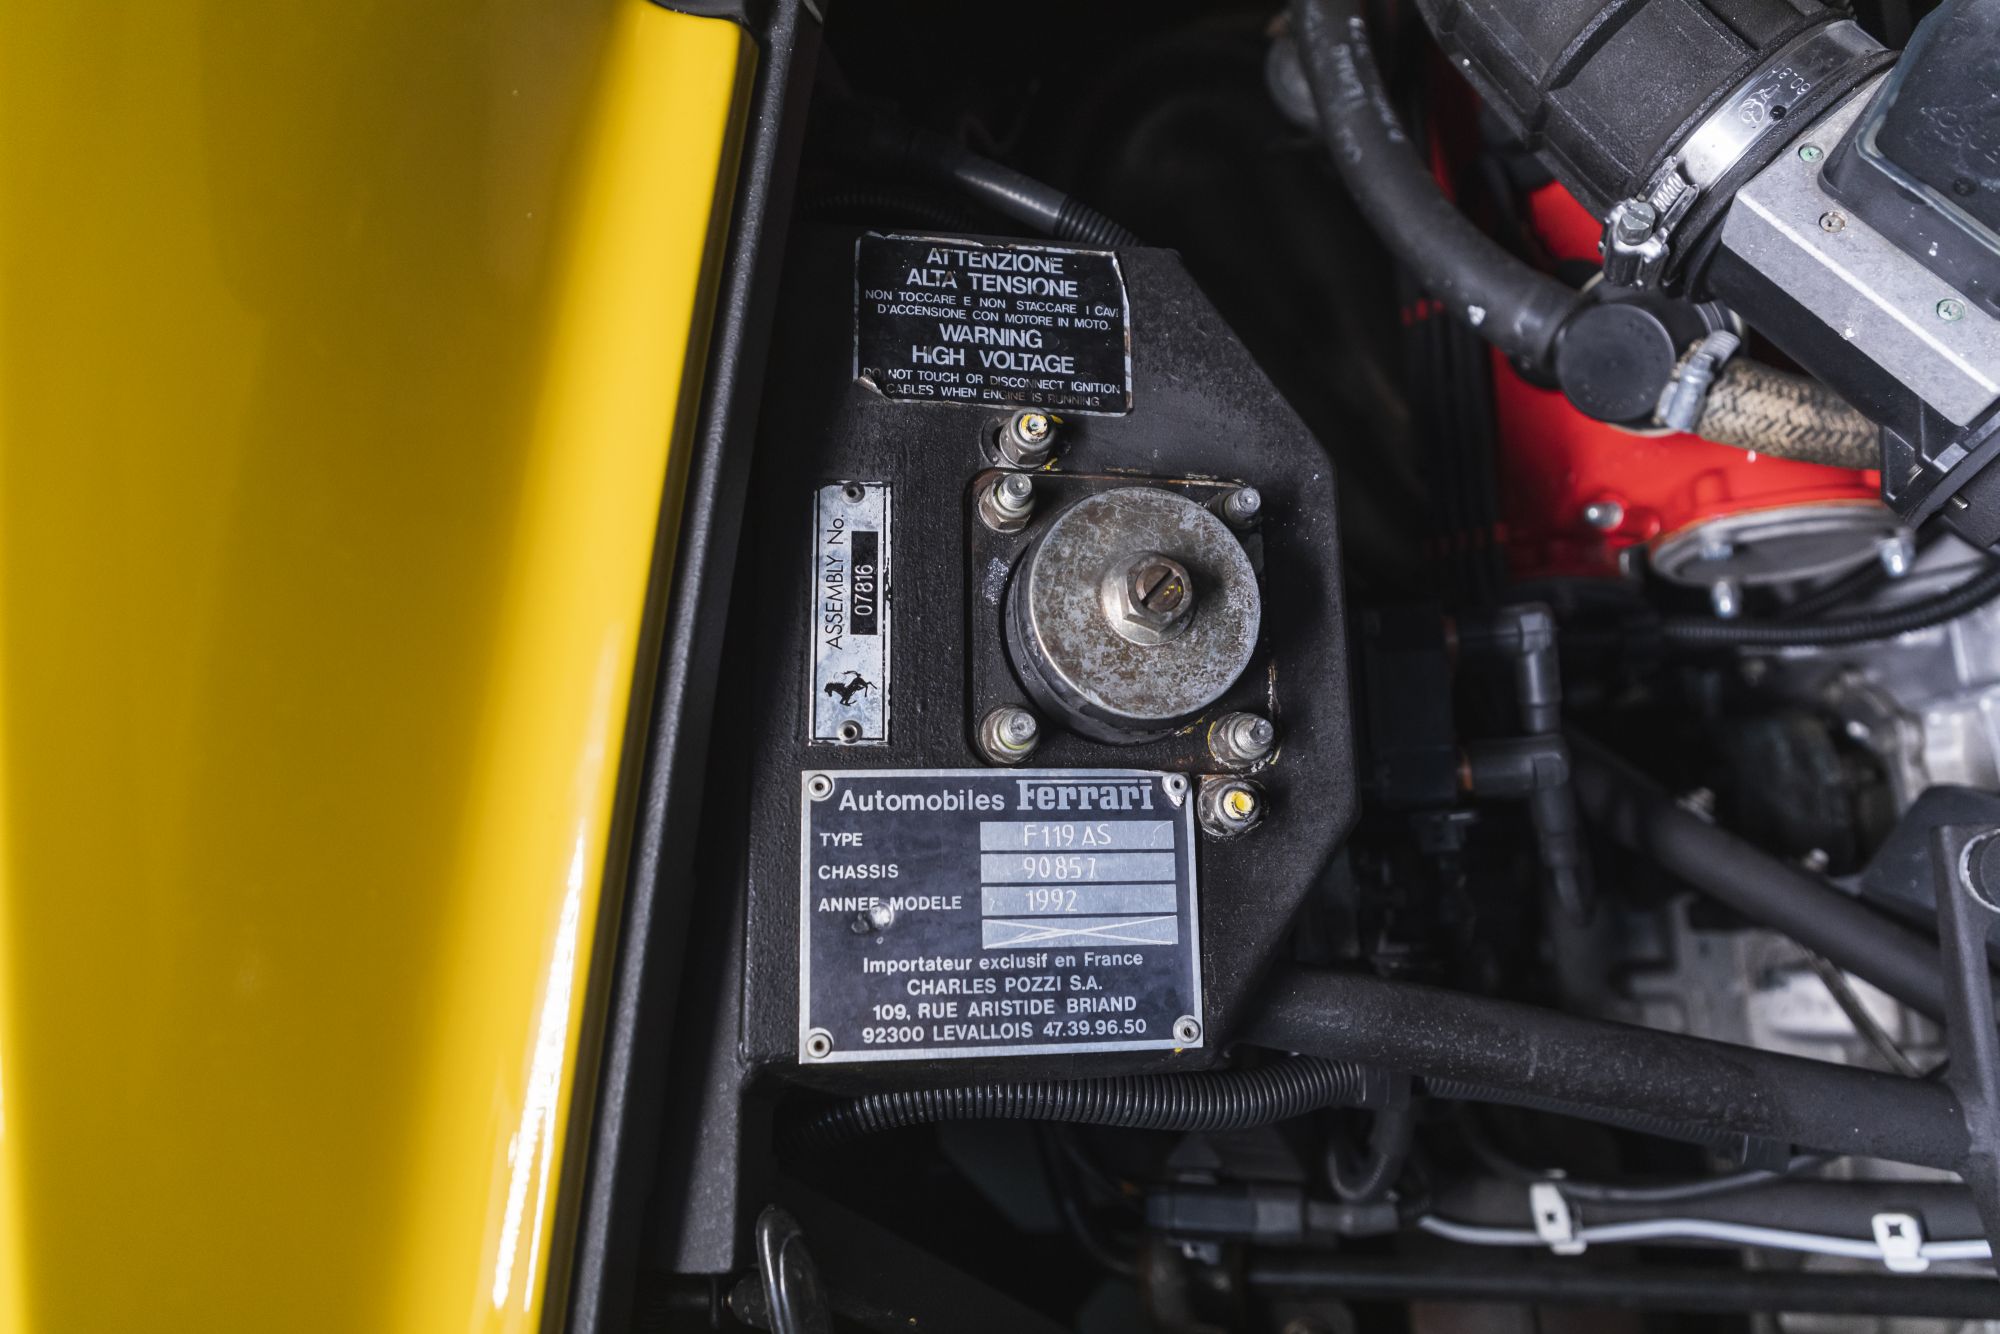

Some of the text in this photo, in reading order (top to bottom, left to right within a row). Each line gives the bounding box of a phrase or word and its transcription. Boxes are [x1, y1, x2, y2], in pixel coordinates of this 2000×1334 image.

[926, 247, 1064, 275] ATTENZIONE
[906, 268, 1079, 298] ALTA TENSIONE
[865, 289, 1119, 318] NON TOCCARE E NON STACCARE I CAVI
[877, 303, 1112, 331] D'ACCENSIONE CON MOTORE IN MOTO.
[939, 323, 1043, 349] WARNING
[912, 345, 1075, 375] HIGH VOLTAGE
[886, 383, 934, 395] CABLES
[940, 386, 977, 398] WHEN
[983, 388, 1025, 400] ENGINE
[1032, 392, 1042, 403] IS
[888, 368, 913, 380] NOT
[917, 370, 960, 383] TOUCH
[965, 373, 984, 384] OR
[990, 375, 1064, 391] DISCONNECT
[1071, 381, 1120, 394] IGNITION
[825, 514, 845, 650] ASSEMBLY No.
[854, 564, 874, 616] 07816
[838, 779, 1154, 812] Automobiles Ferrari
[820, 832, 863, 848] TYPE
[818, 856, 1096, 880] CHASSIS 90857
[818, 888, 1078, 912] ANNEE MODELE 1992
[863, 951, 1144, 976] Importateur exclusif en France
[906, 975, 1103, 996] CHARLES POZZI S.A.
[872, 996, 1137, 1022] 109, RUE ARISTIDE BRIAND
[861, 1018, 1147, 1044] 92300 LEVALLOIS 47.39.96.50
